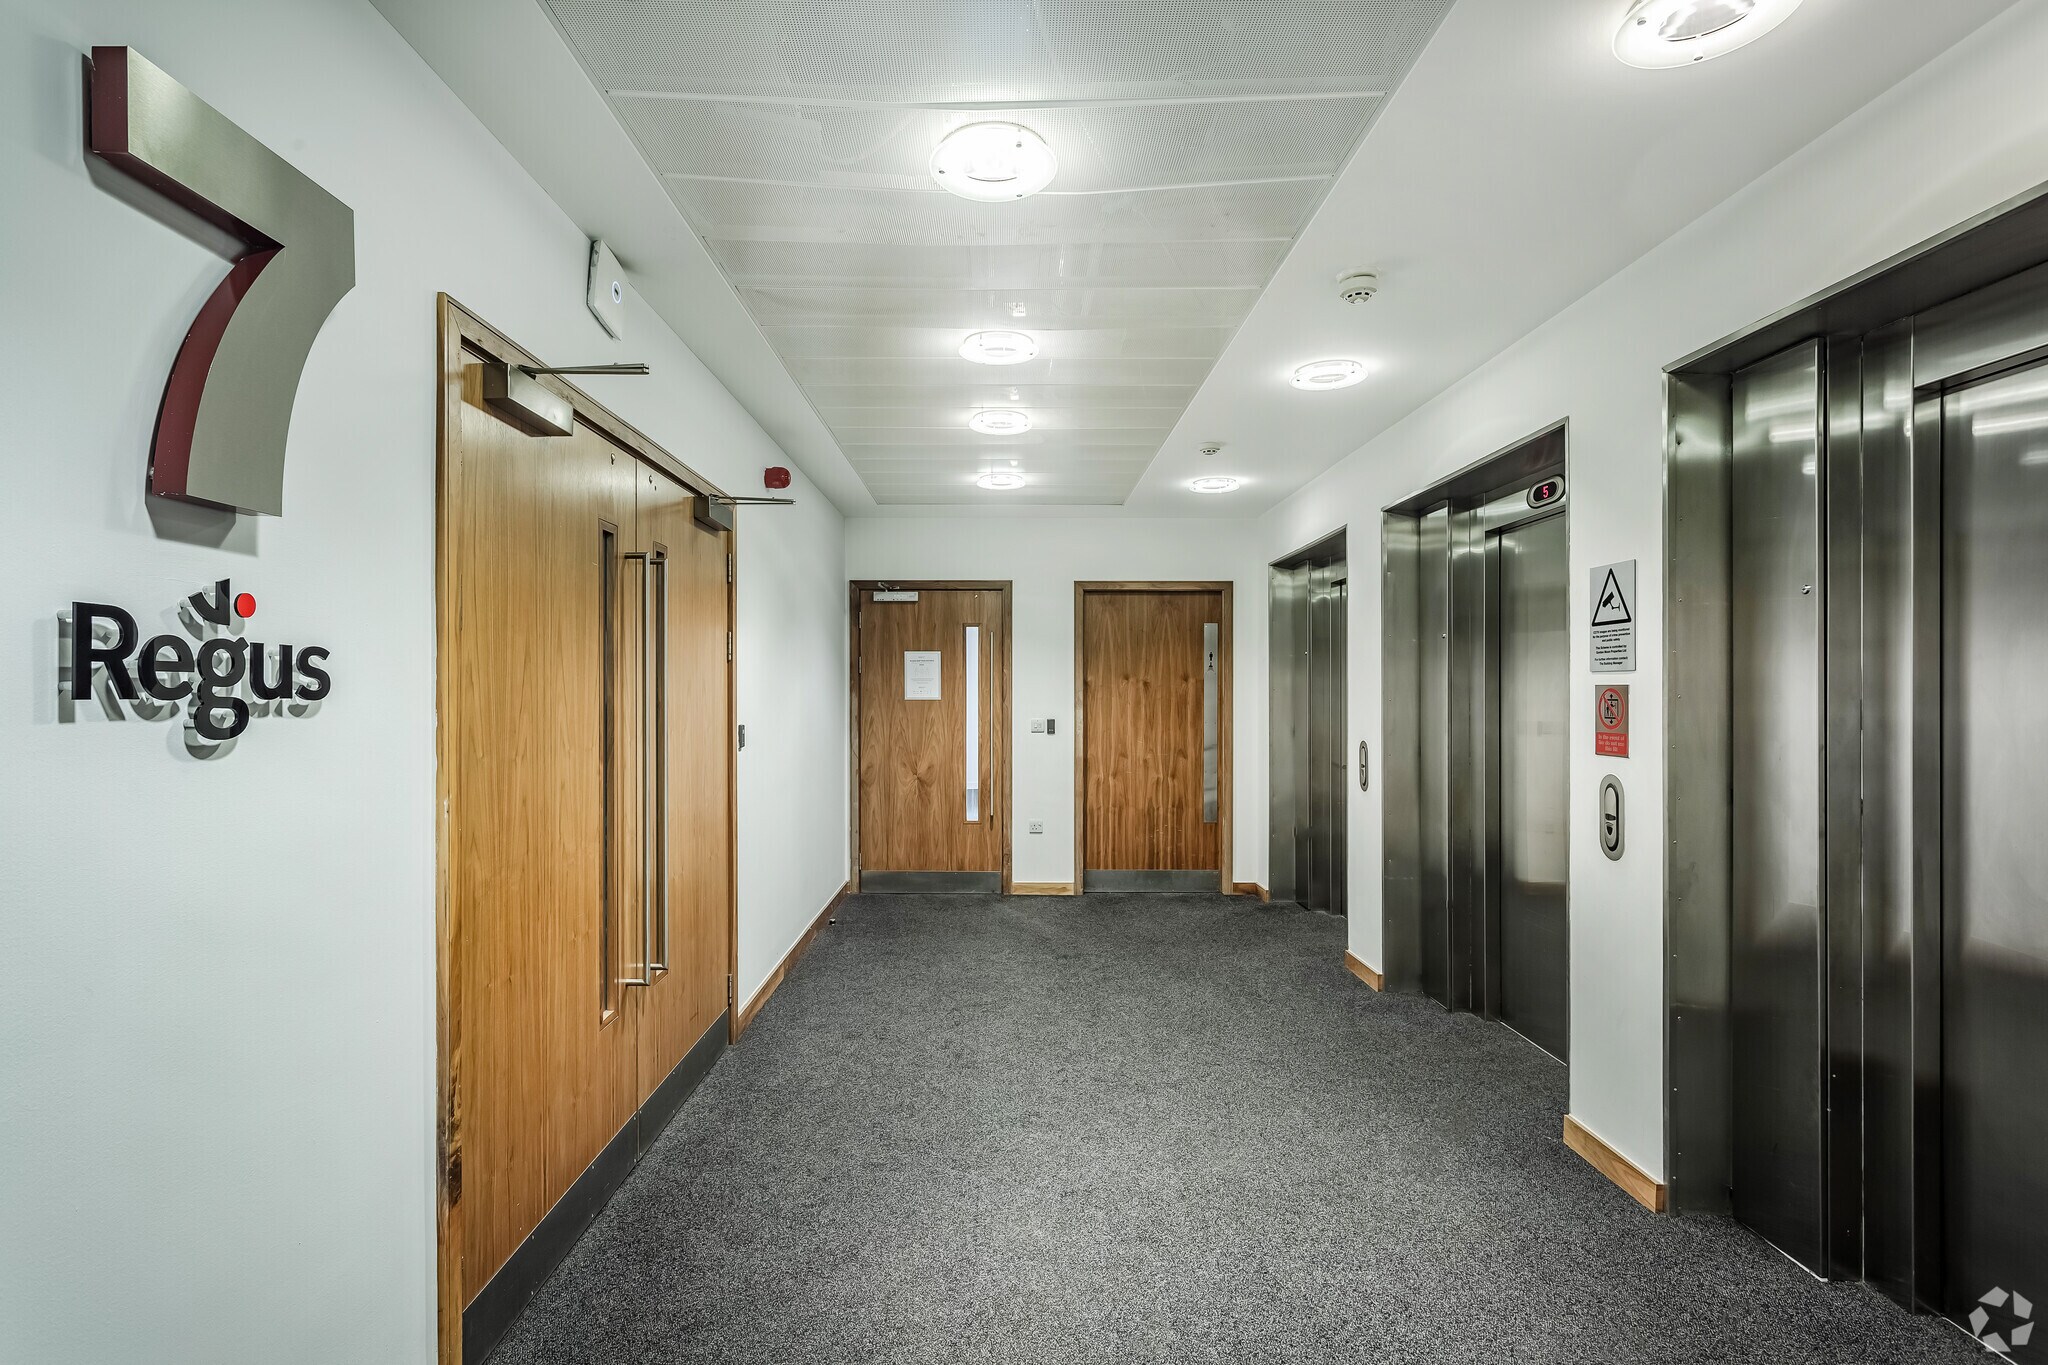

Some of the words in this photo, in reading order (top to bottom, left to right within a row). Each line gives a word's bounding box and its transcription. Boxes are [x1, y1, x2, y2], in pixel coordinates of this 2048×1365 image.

[92, 45, 355, 517] 7
[1542, 485, 1549, 498] 5
[71, 600, 331, 740] Regus
